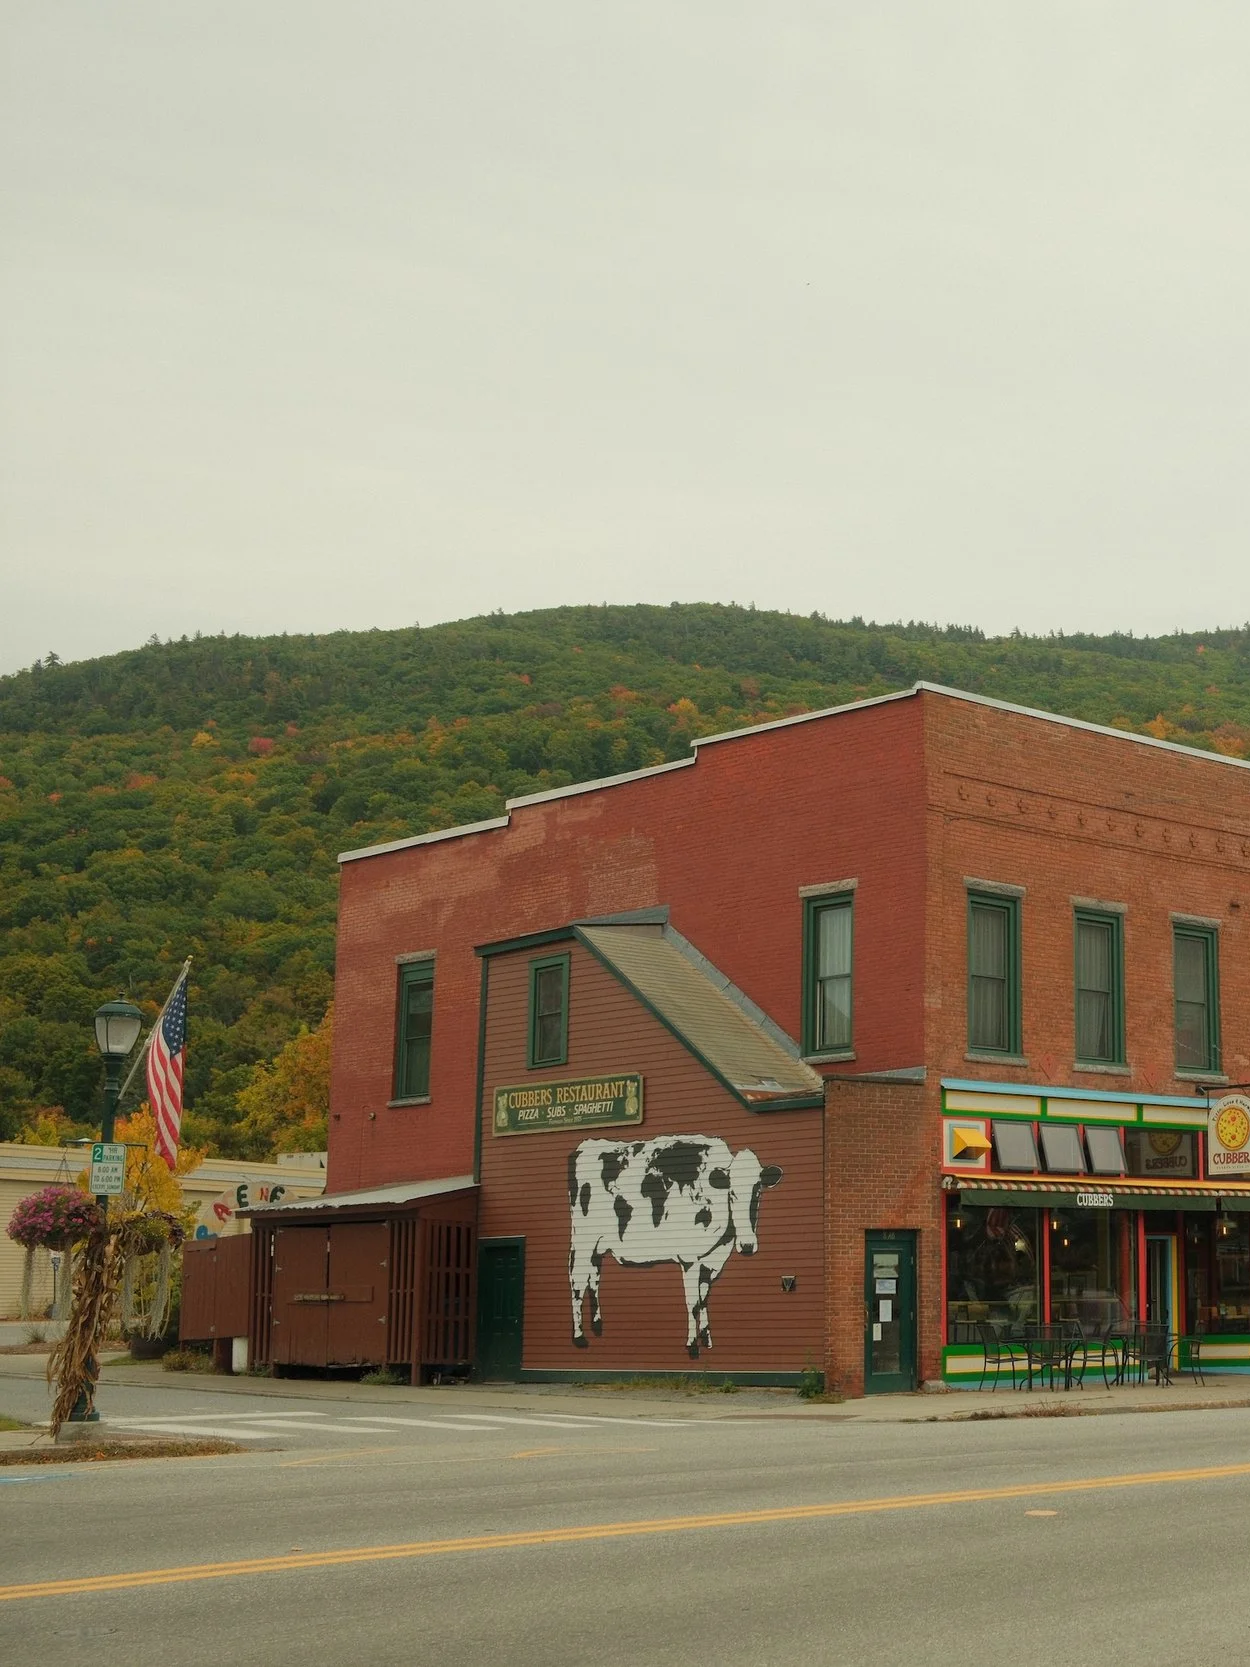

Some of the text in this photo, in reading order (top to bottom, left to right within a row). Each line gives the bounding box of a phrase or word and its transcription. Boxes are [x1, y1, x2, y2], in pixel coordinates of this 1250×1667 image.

[508, 1080, 626, 1109] CUBBERS RESTAURANT
[517, 1100, 614, 1121] PIZZA SUBS SPAGHETTI
[94, 1147, 102, 1160] 2
[103, 1154, 123, 1162] PARKING
[1076, 1192, 1114, 1207] CUBBERS
